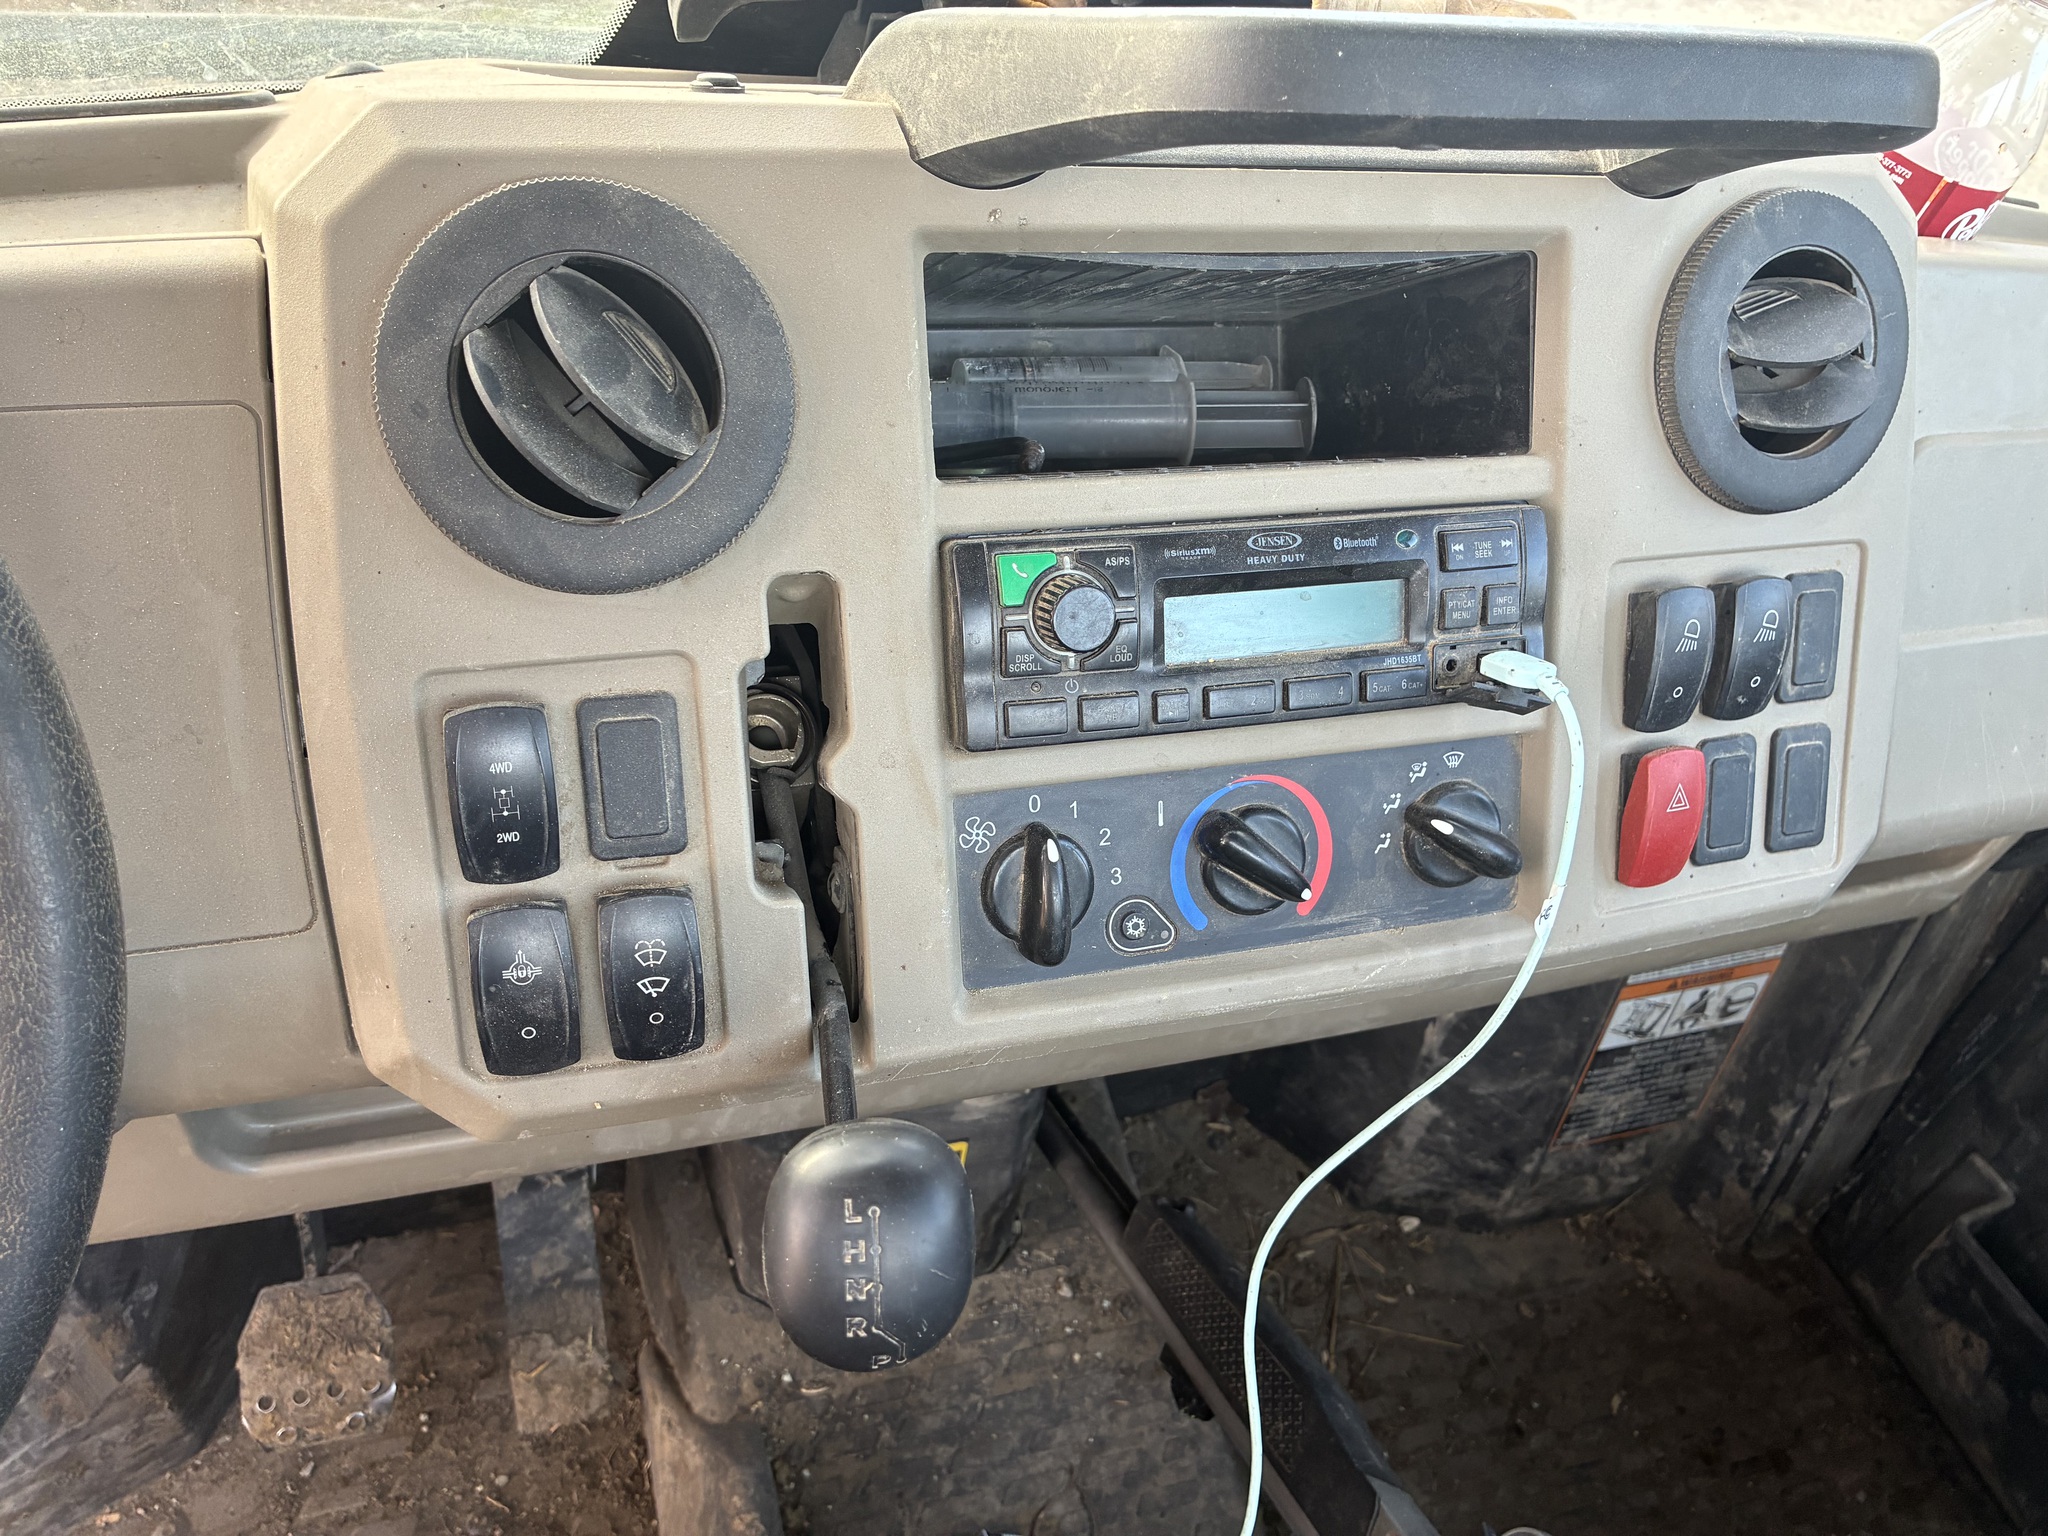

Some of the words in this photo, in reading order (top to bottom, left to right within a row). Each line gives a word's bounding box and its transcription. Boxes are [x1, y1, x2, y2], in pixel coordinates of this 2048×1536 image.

[1255, 535, 1293, 548] JENSEN
[1474, 541, 1492, 550] TUNE
[1247, 556, 1277, 565] HEAVY
[1281, 553, 1306, 563] DUTY
[1475, 550, 1493, 558] SEEK
[1105, 556, 1131, 566] AS/PS
[1448, 599, 1476, 609] PTY/CAT
[1496, 596, 1513, 604] INFO
[1452, 611, 1471, 619] MENU
[1493, 606, 1517, 615] ENTER
[1115, 645, 1128, 654] EQ
[1016, 654, 1035, 663] DISP
[1109, 653, 1133, 663] LOUD
[1009, 662, 1042, 672] SCROLL
[489, 762, 513, 774] 4WD
[1069, 800, 1078, 819] 1
[496, 831, 520, 843] 2WD
[1099, 828, 1111, 846] 2
[1110, 866, 1122, 885] 3
[843, 1198, 862, 1223] L
[842, 1239, 867, 1264] H
[846, 1278, 868, 1302] N
[846, 1316, 868, 1338] R
[871, 1354, 892, 1369] P
